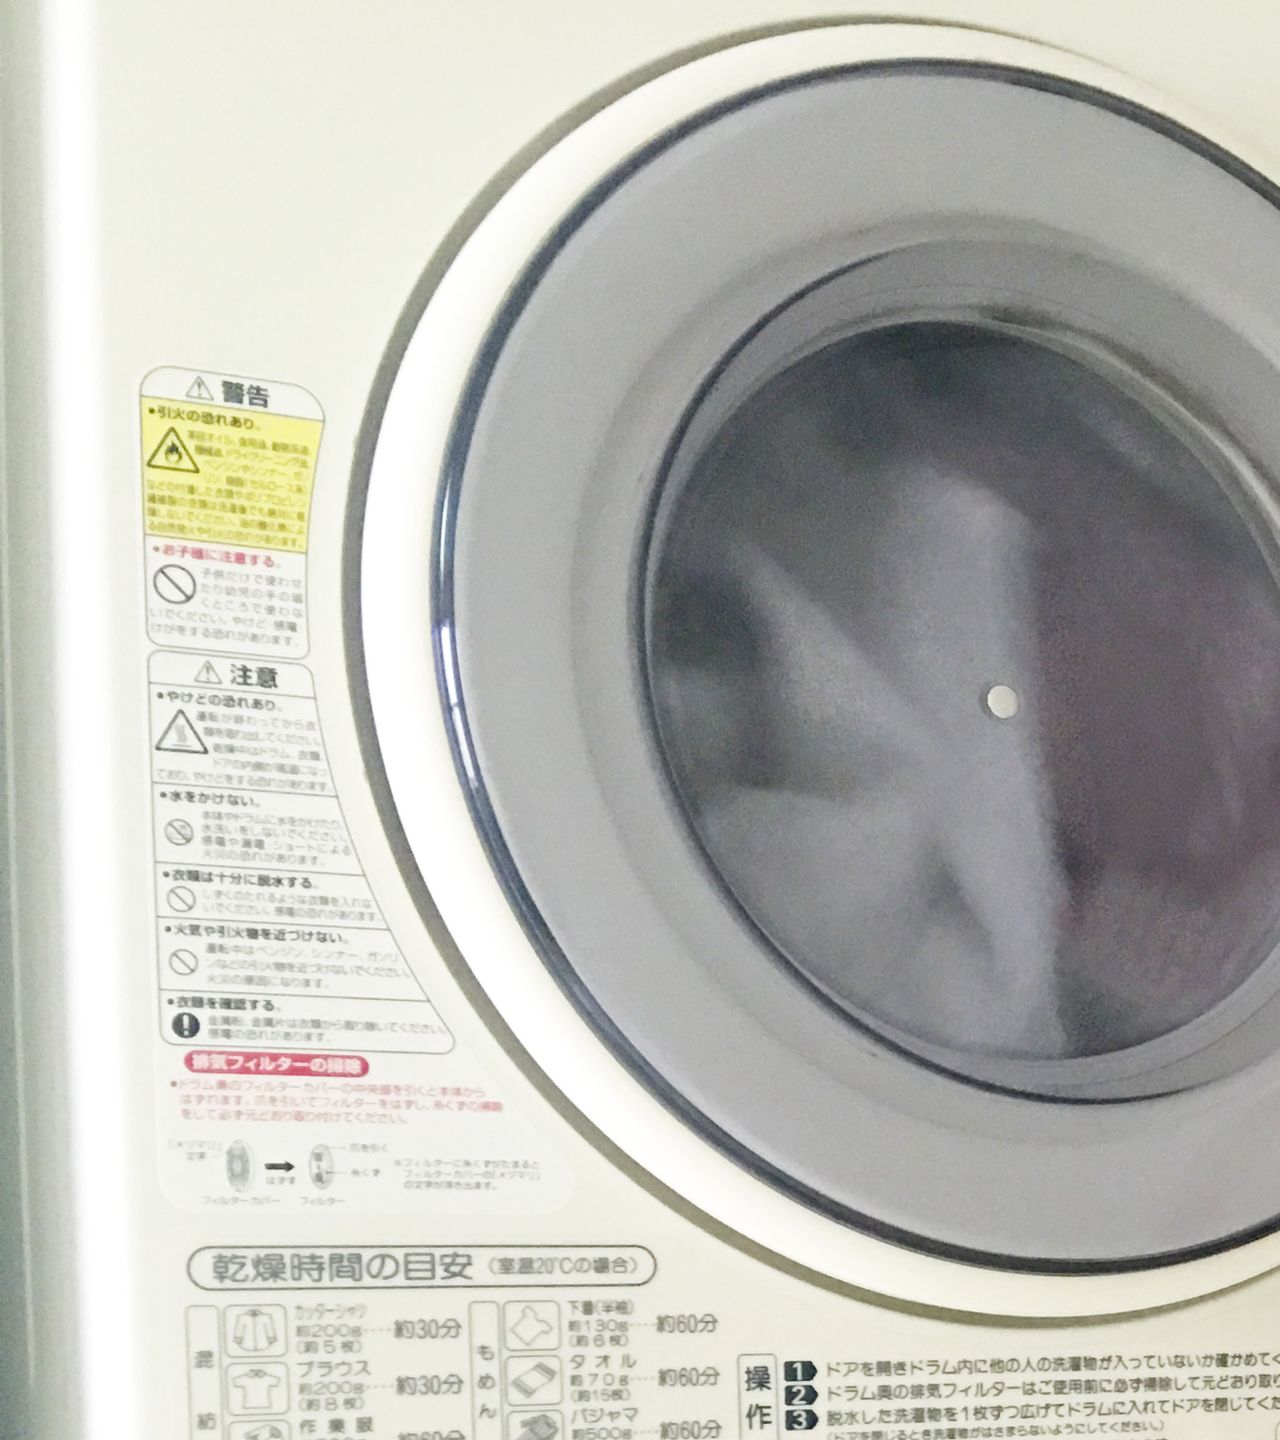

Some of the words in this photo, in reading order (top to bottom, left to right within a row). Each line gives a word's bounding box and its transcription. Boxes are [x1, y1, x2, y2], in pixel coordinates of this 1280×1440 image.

[221, 380, 269, 408] 警告
[230, 664, 278, 688] 注意
[170, 790, 260, 808] 水をかけない。
[212, 1251, 474, 1284] 乾燥時間の目安
[394, 1318, 462, 1339] 約30分
[656, 1313, 718, 1334] 約60分
[297, 1360, 372, 1377] ブラウス
[570, 1354, 638, 1369] タオル
[793, 1363, 803, 1380] 1
[396, 1374, 464, 1395] 約30分
[658, 1366, 720, 1387] 約60分
[792, 1387, 808, 1404] 2
[660, 1419, 722, 1440] 約60分
[792, 1412, 808, 1429] 3
